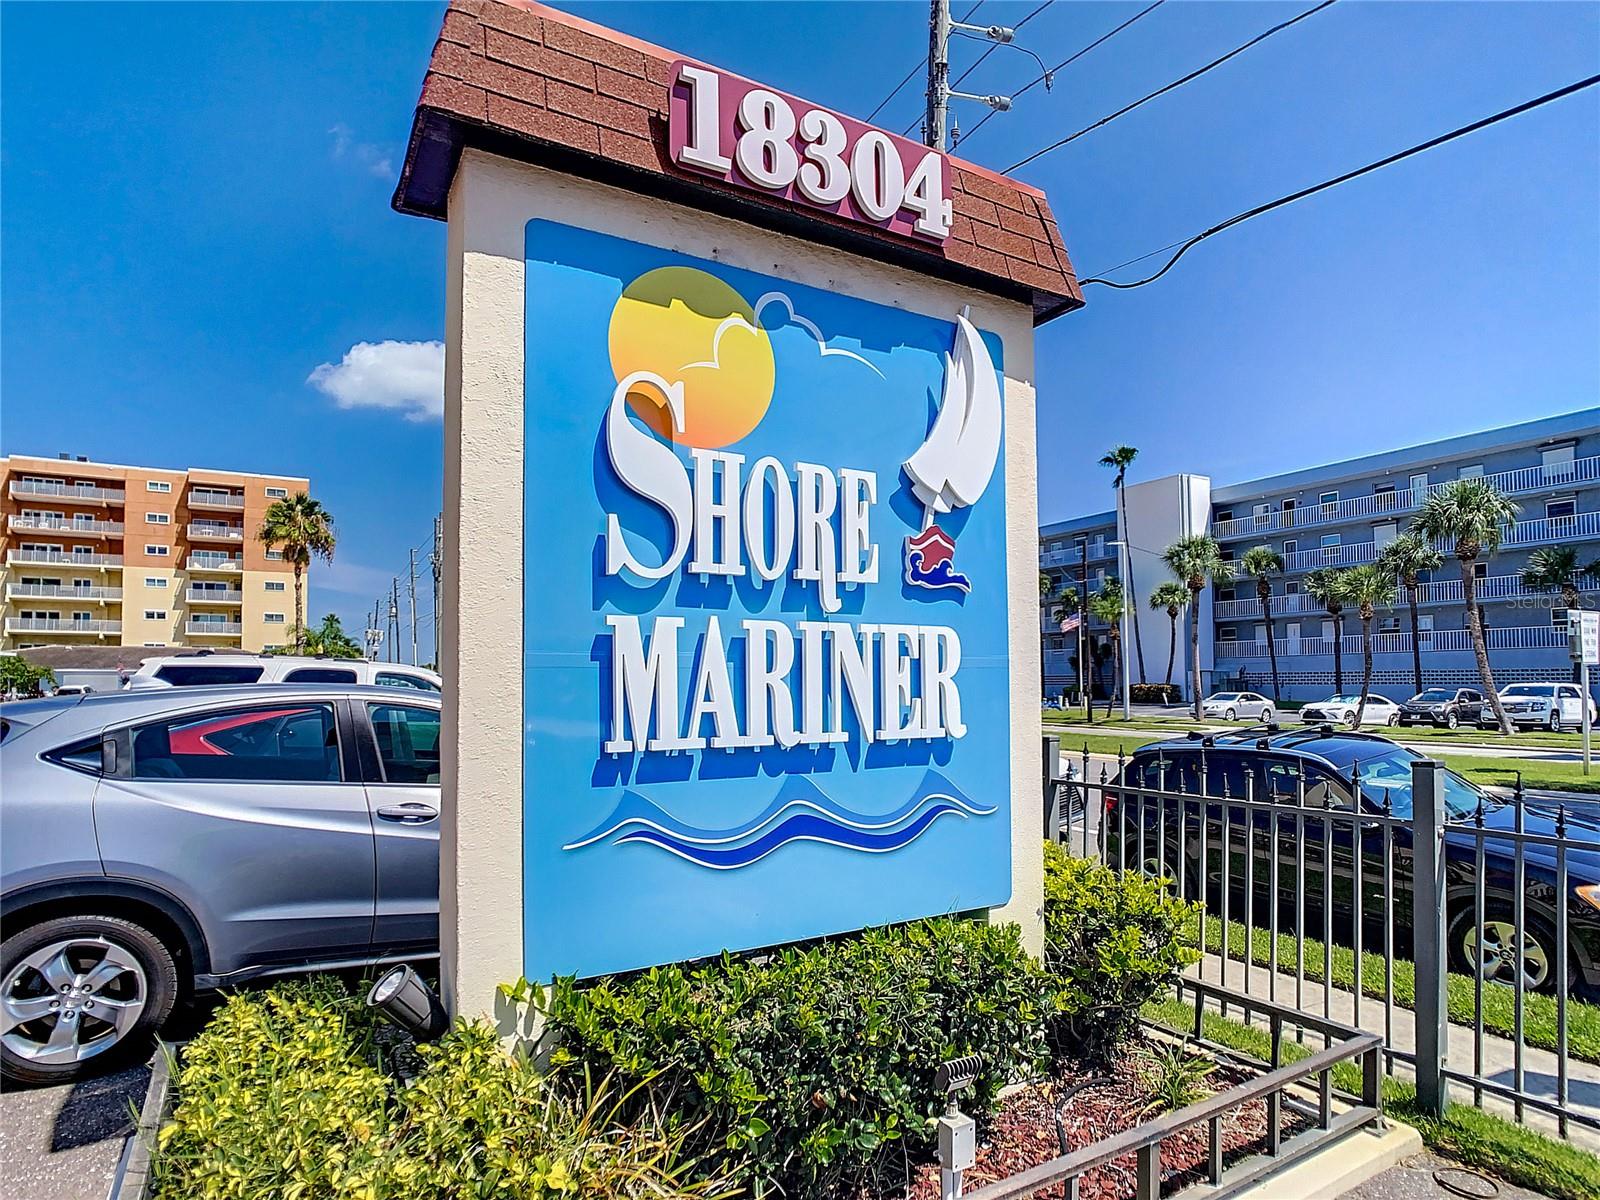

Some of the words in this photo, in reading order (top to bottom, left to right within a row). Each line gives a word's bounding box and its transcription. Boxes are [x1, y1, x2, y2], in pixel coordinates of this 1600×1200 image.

[678, 64, 953, 240] 18304
[605, 370, 880, 613] SHORE
[604, 615, 968, 754] MARINER
